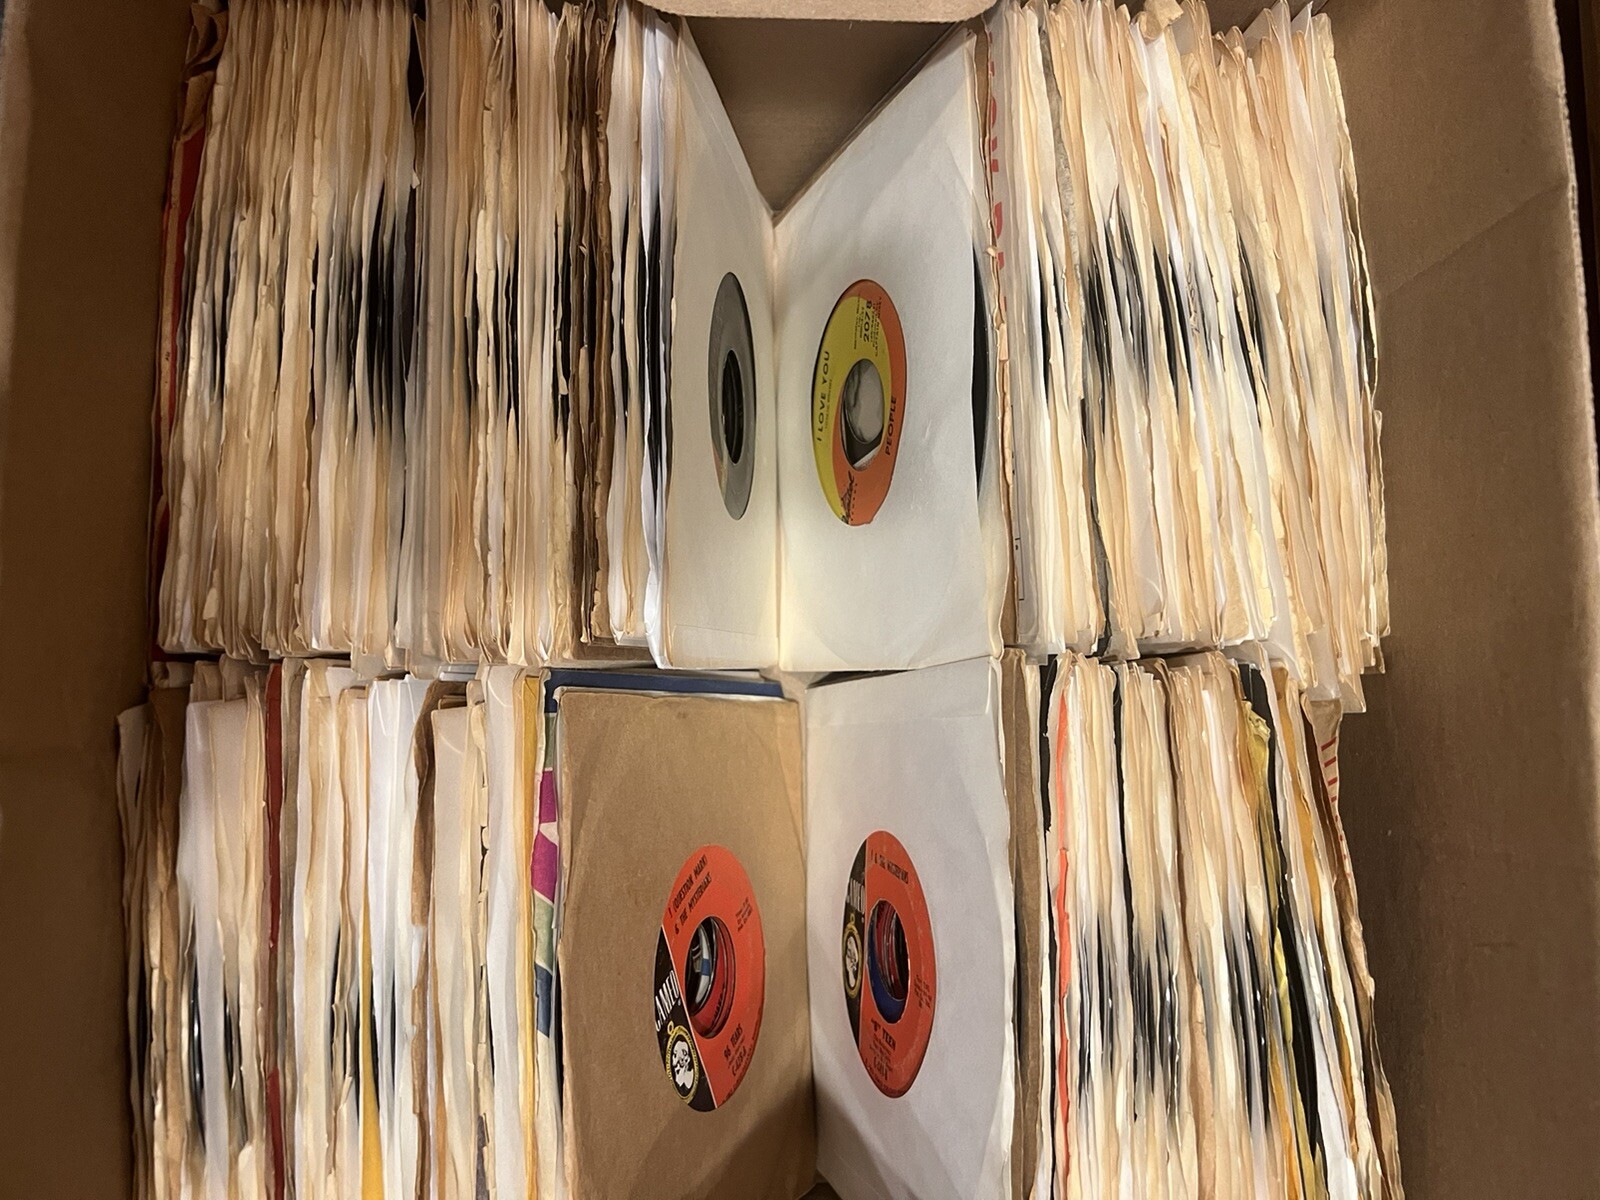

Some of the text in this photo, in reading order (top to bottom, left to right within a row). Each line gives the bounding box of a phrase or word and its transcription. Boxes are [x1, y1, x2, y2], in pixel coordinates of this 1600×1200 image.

[863, 300, 873, 342] 2078
[818, 393, 826, 433] LOVE
[822, 351, 830, 384] YOU
[885, 395, 897, 455] PEOPLE
[846, 877, 866, 915] AMEO
[882, 1028, 896, 1051] TEEN
